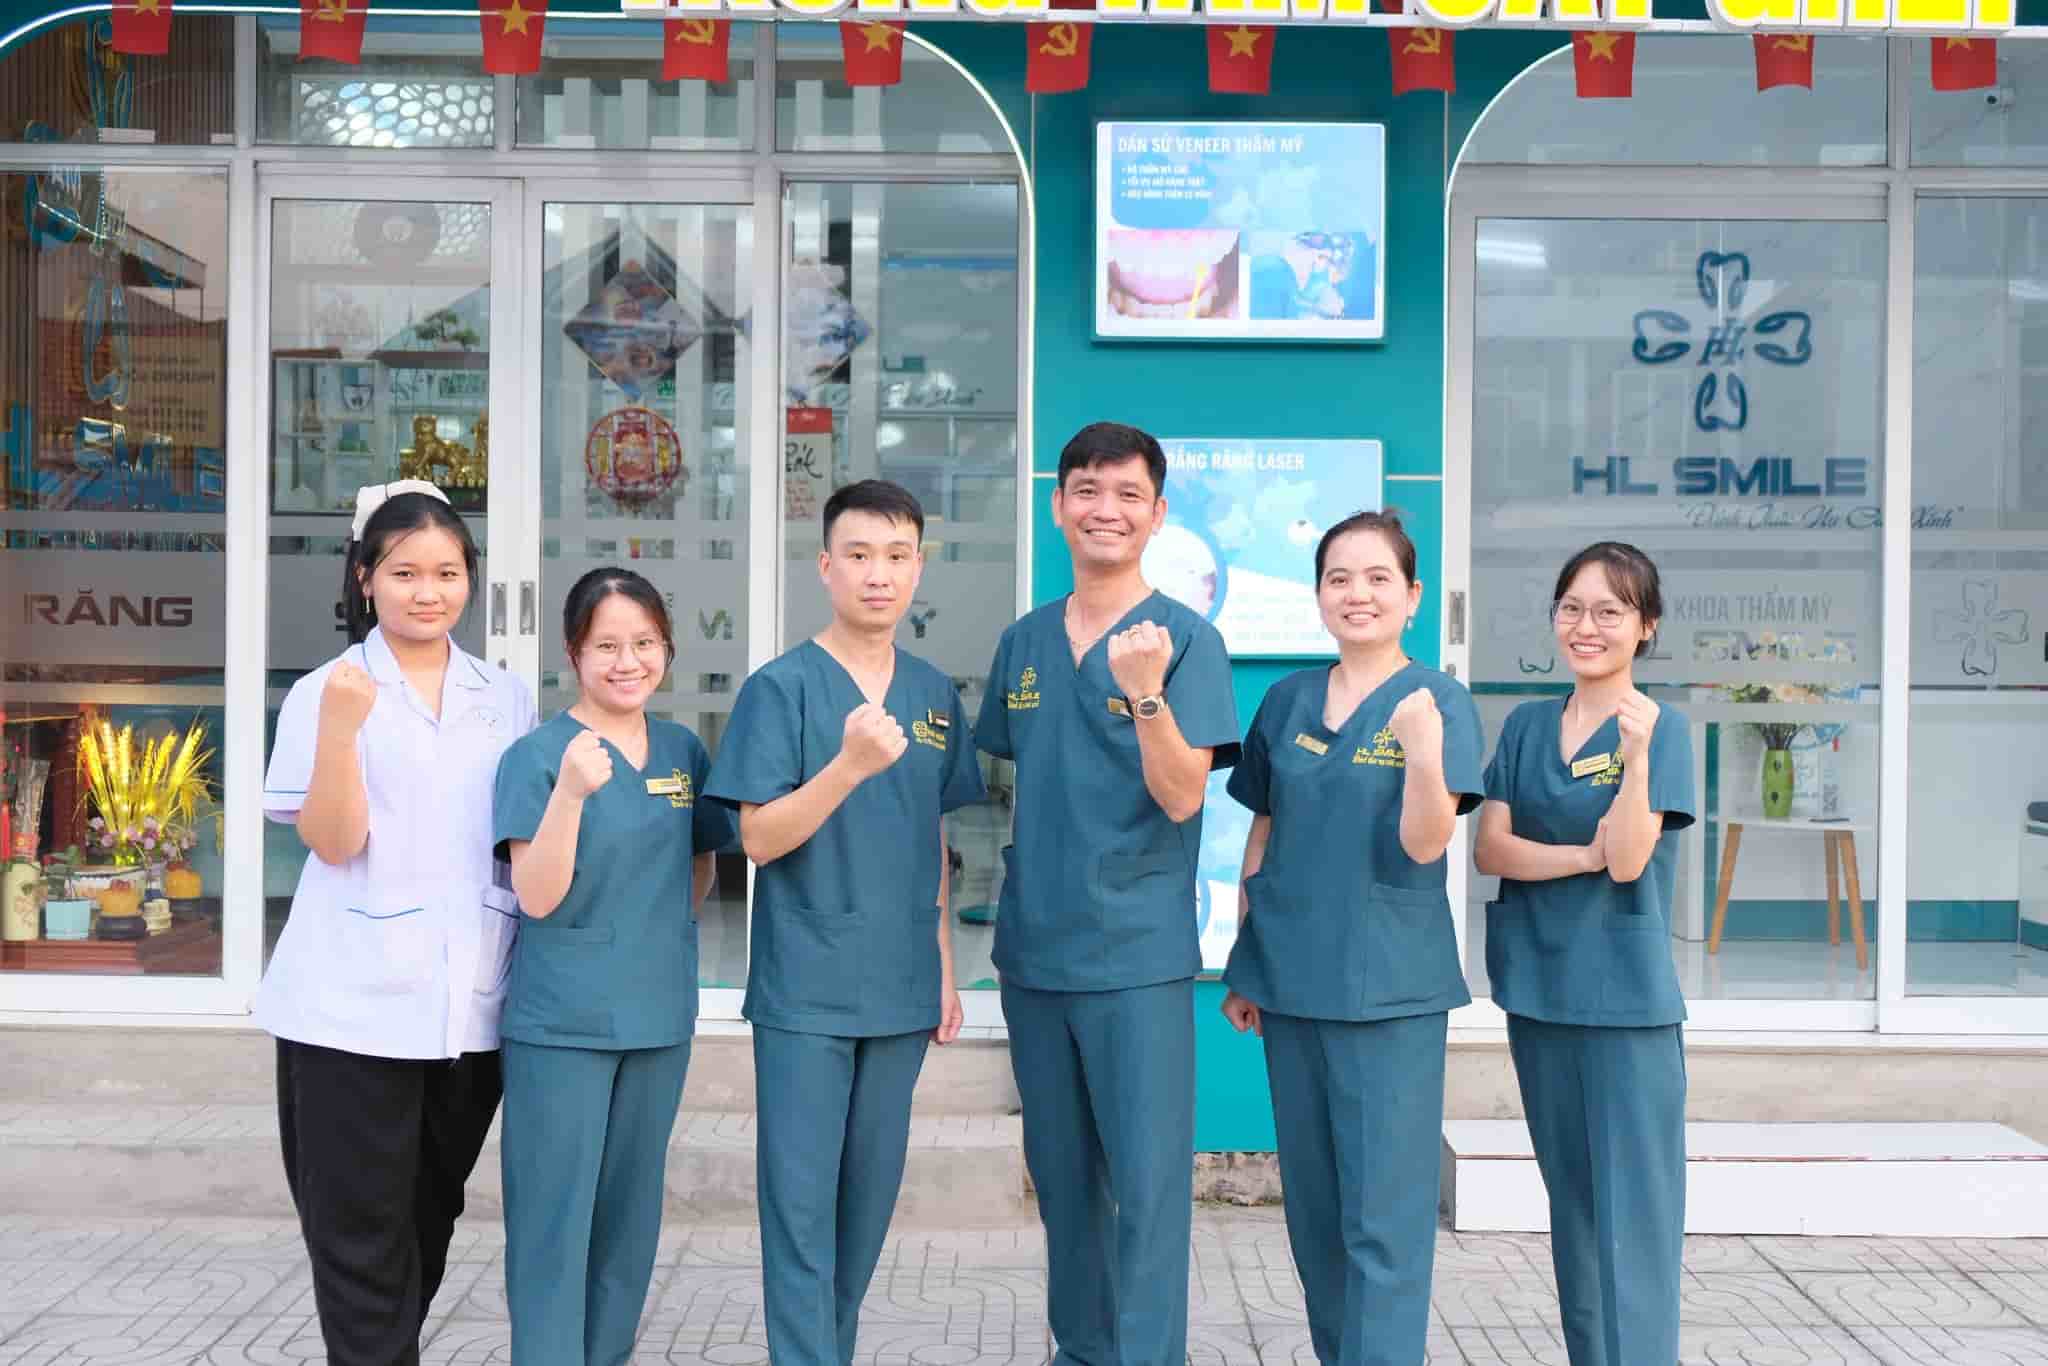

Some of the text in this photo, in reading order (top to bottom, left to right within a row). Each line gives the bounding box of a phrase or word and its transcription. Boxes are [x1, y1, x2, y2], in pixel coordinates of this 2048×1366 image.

[1175, 135, 1231, 153] VENEER
[1165, 445, 1207, 471] RẮNG
[1259, 451, 1305, 470] LASER
[1572, 455, 1867, 497] HL SMILE
[23, 585, 193, 627] RĂNG
[1673, 584, 1833, 623] KHOA THẨM MỸ
